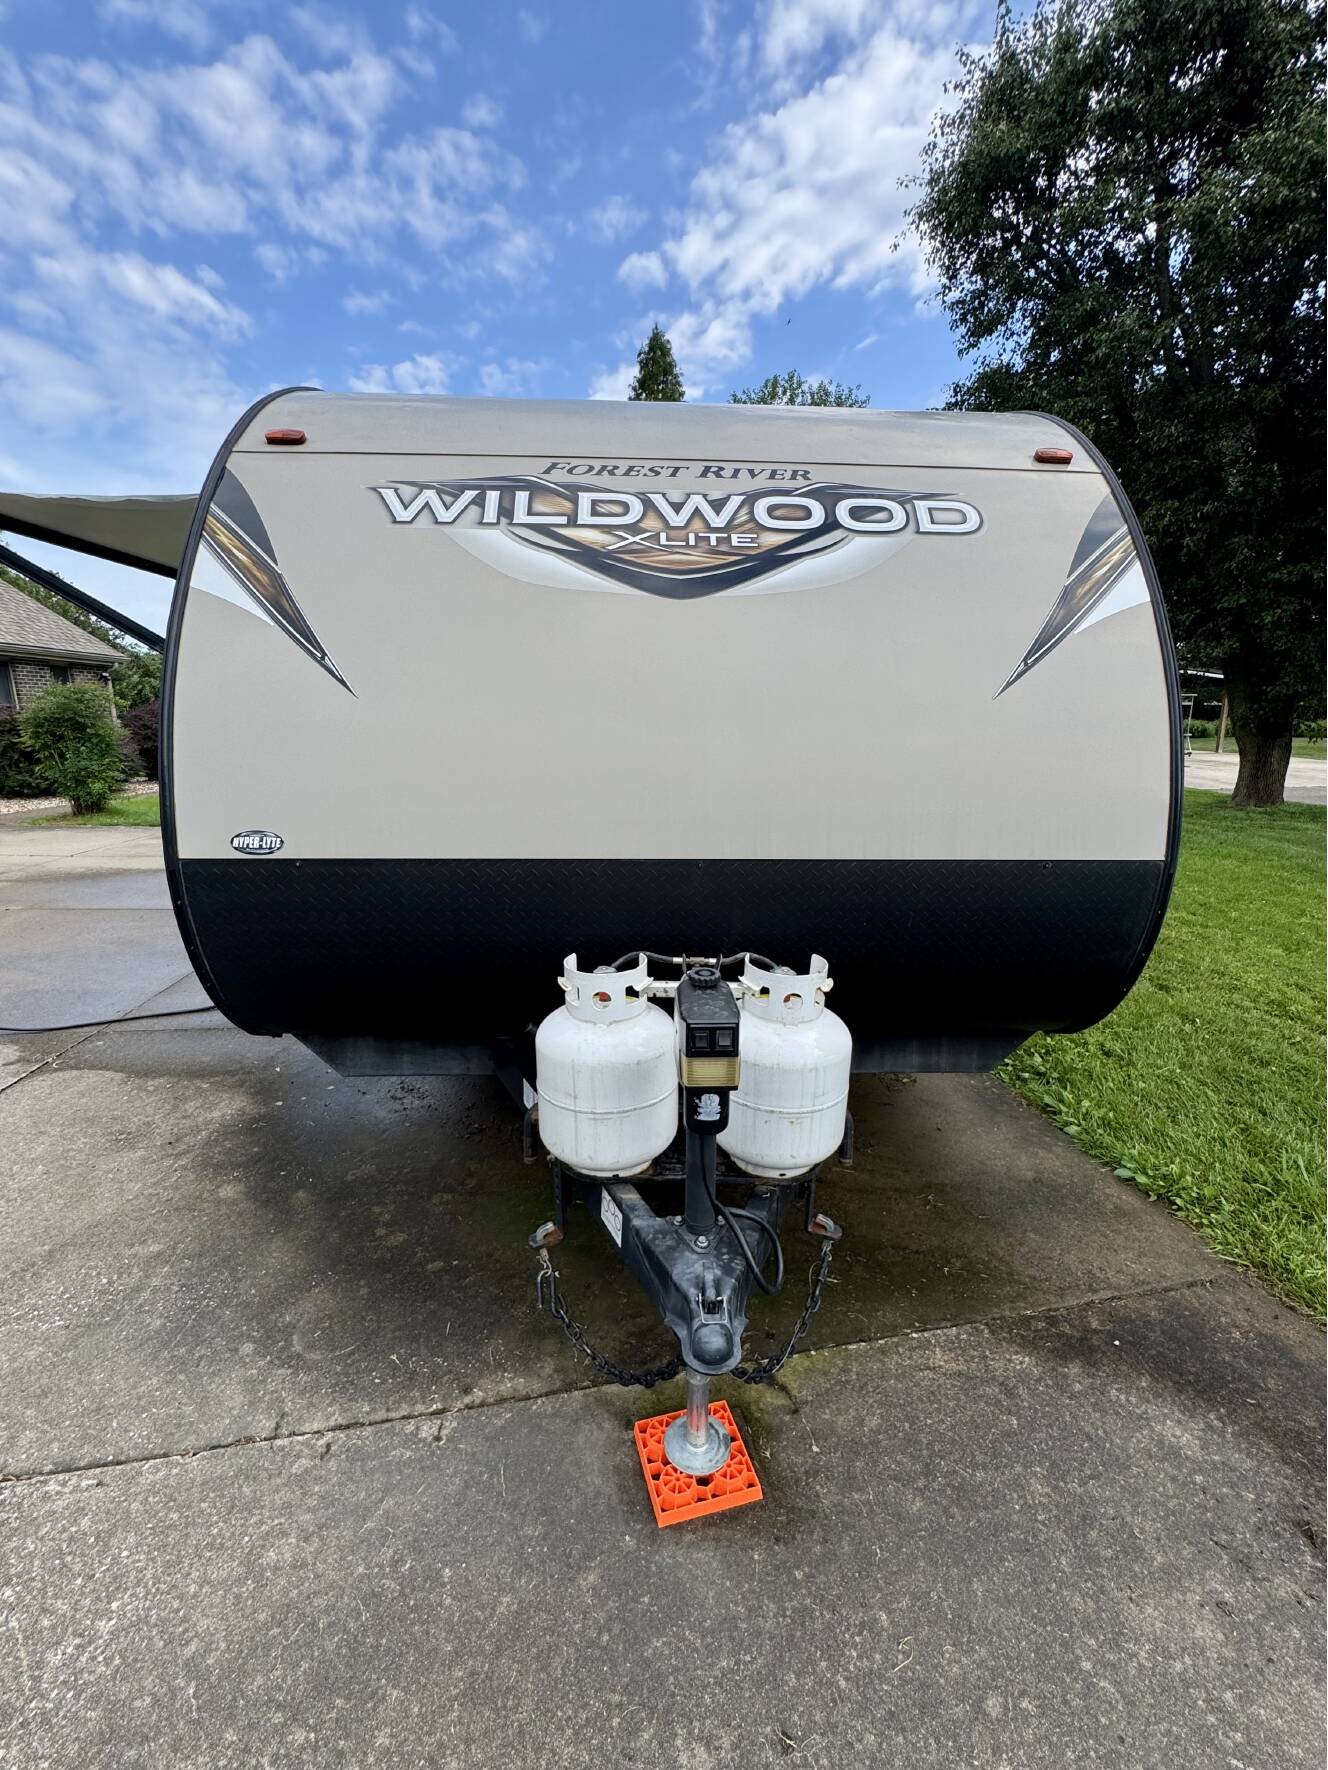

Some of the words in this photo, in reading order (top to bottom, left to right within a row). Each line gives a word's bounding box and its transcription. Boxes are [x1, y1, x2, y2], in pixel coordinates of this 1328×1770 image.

[537, 461, 689, 479] FOREST
[697, 464, 813, 481] RIVER
[374, 486, 984, 534] WILDWOOD
[232, 836, 282, 849] HYPER-LYTE
